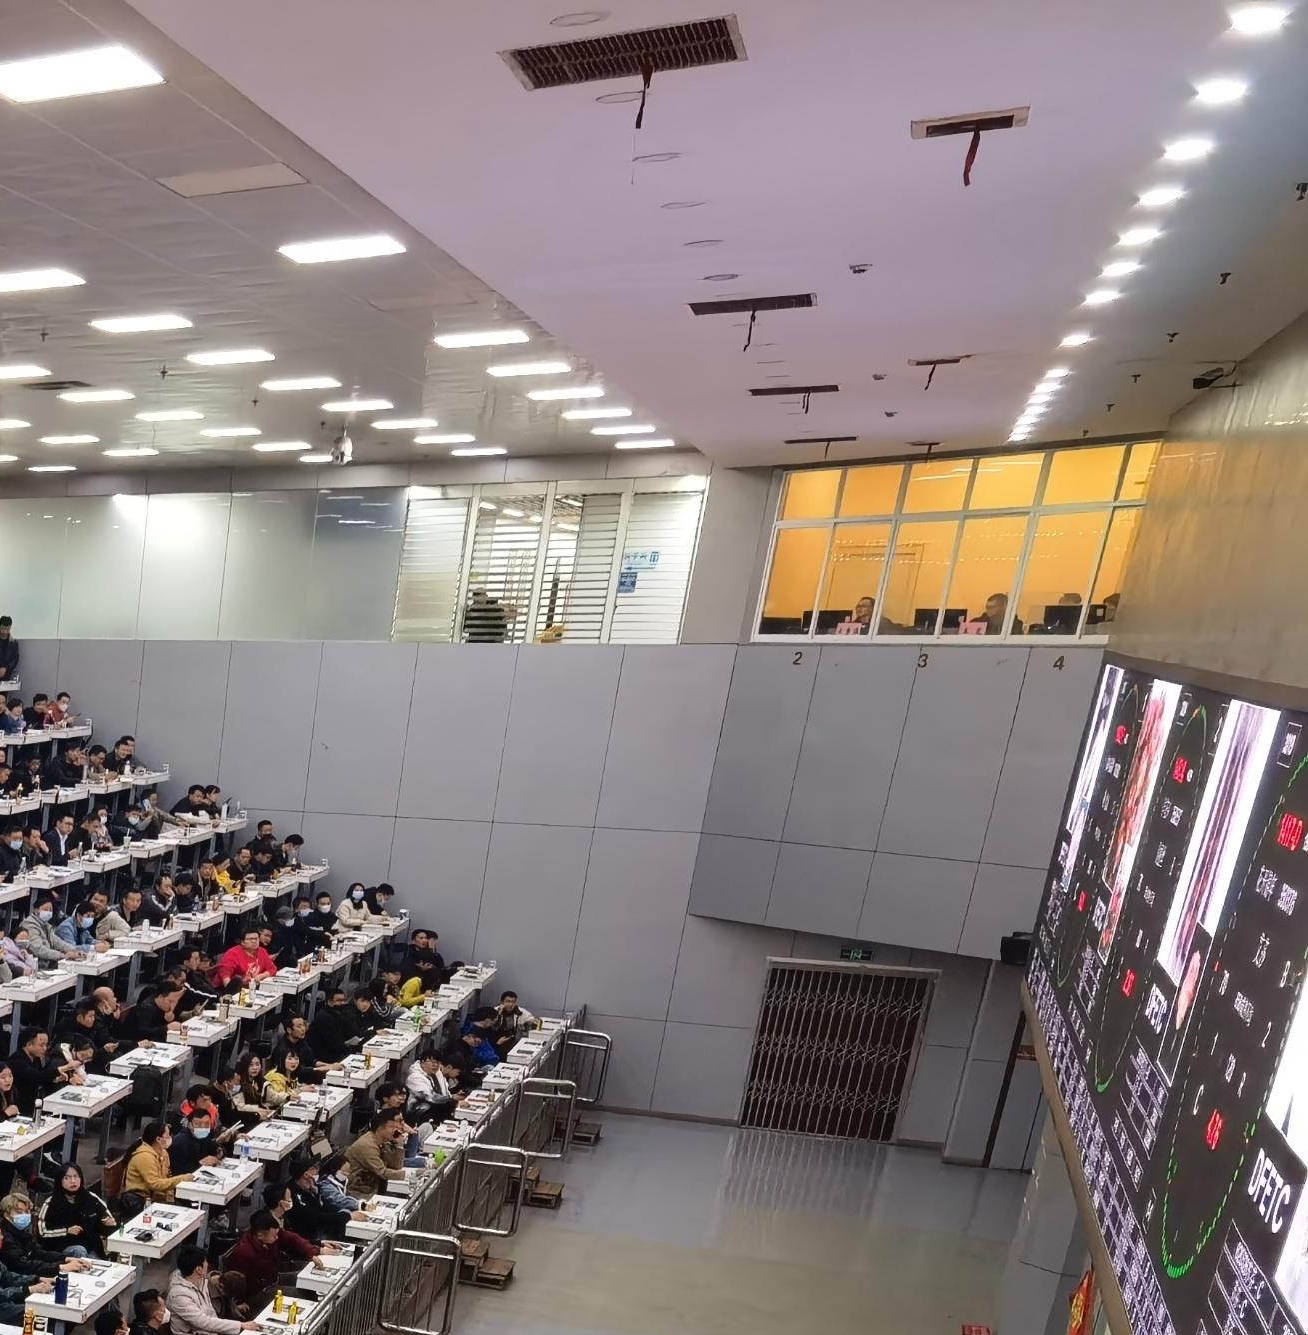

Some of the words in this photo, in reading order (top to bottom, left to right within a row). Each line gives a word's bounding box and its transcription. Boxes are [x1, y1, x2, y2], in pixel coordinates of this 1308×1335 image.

[792, 651, 803, 665] 2
[917, 653, 929, 668] 3
[1053, 656, 1065, 671] 4
[1247, 1148, 1292, 1234] DFETC
